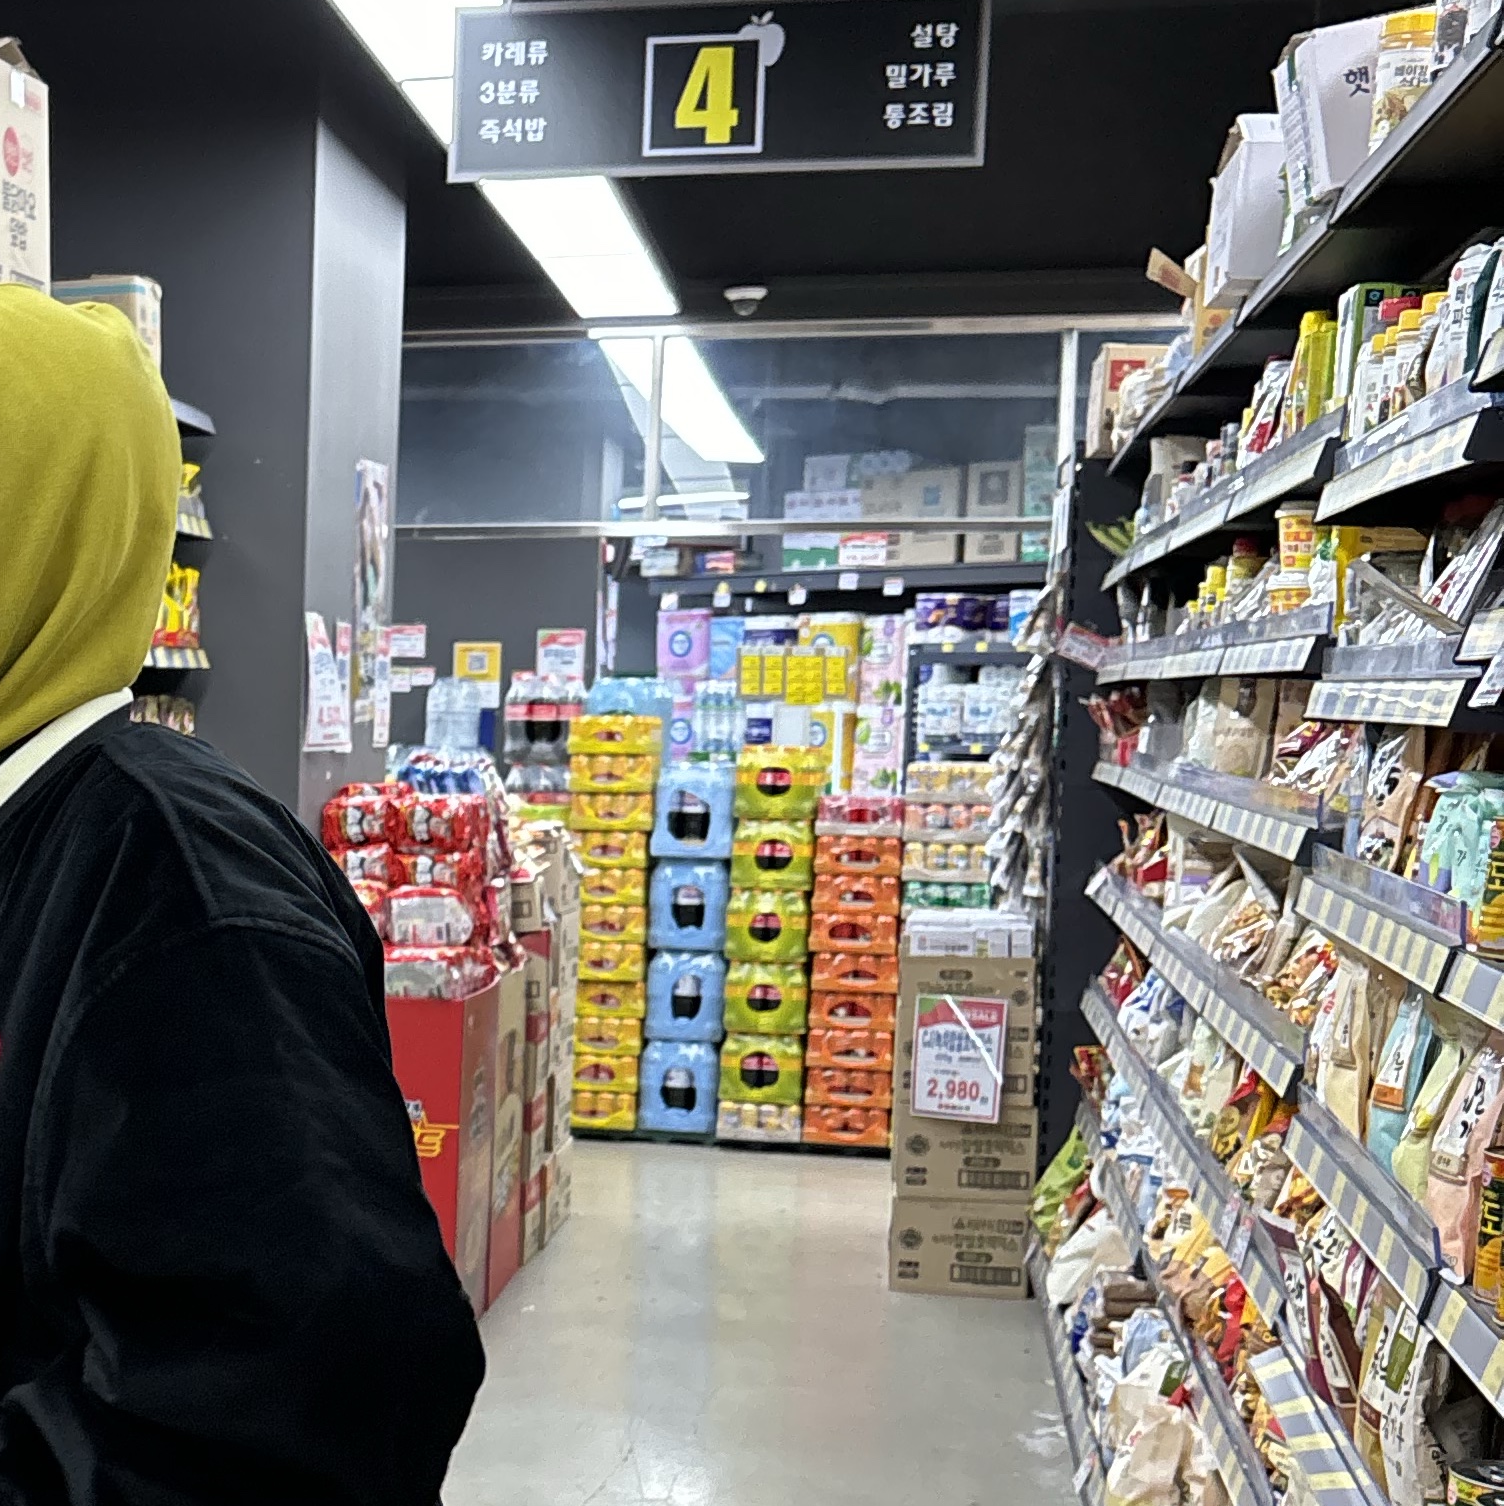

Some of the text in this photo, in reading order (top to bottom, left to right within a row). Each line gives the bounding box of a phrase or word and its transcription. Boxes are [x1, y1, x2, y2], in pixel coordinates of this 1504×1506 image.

[909, 21, 960, 49] 설탕
[480, 40, 549, 67] 카레류
[884, 61, 957, 89] 밀가루
[479, 79, 541, 105] 3분류
[674, 47, 741, 144] 4
[882, 101, 955, 128] 통조림
[478, 117, 548, 143] 즉석밥
[927, 1078, 981, 1103] 2,980
